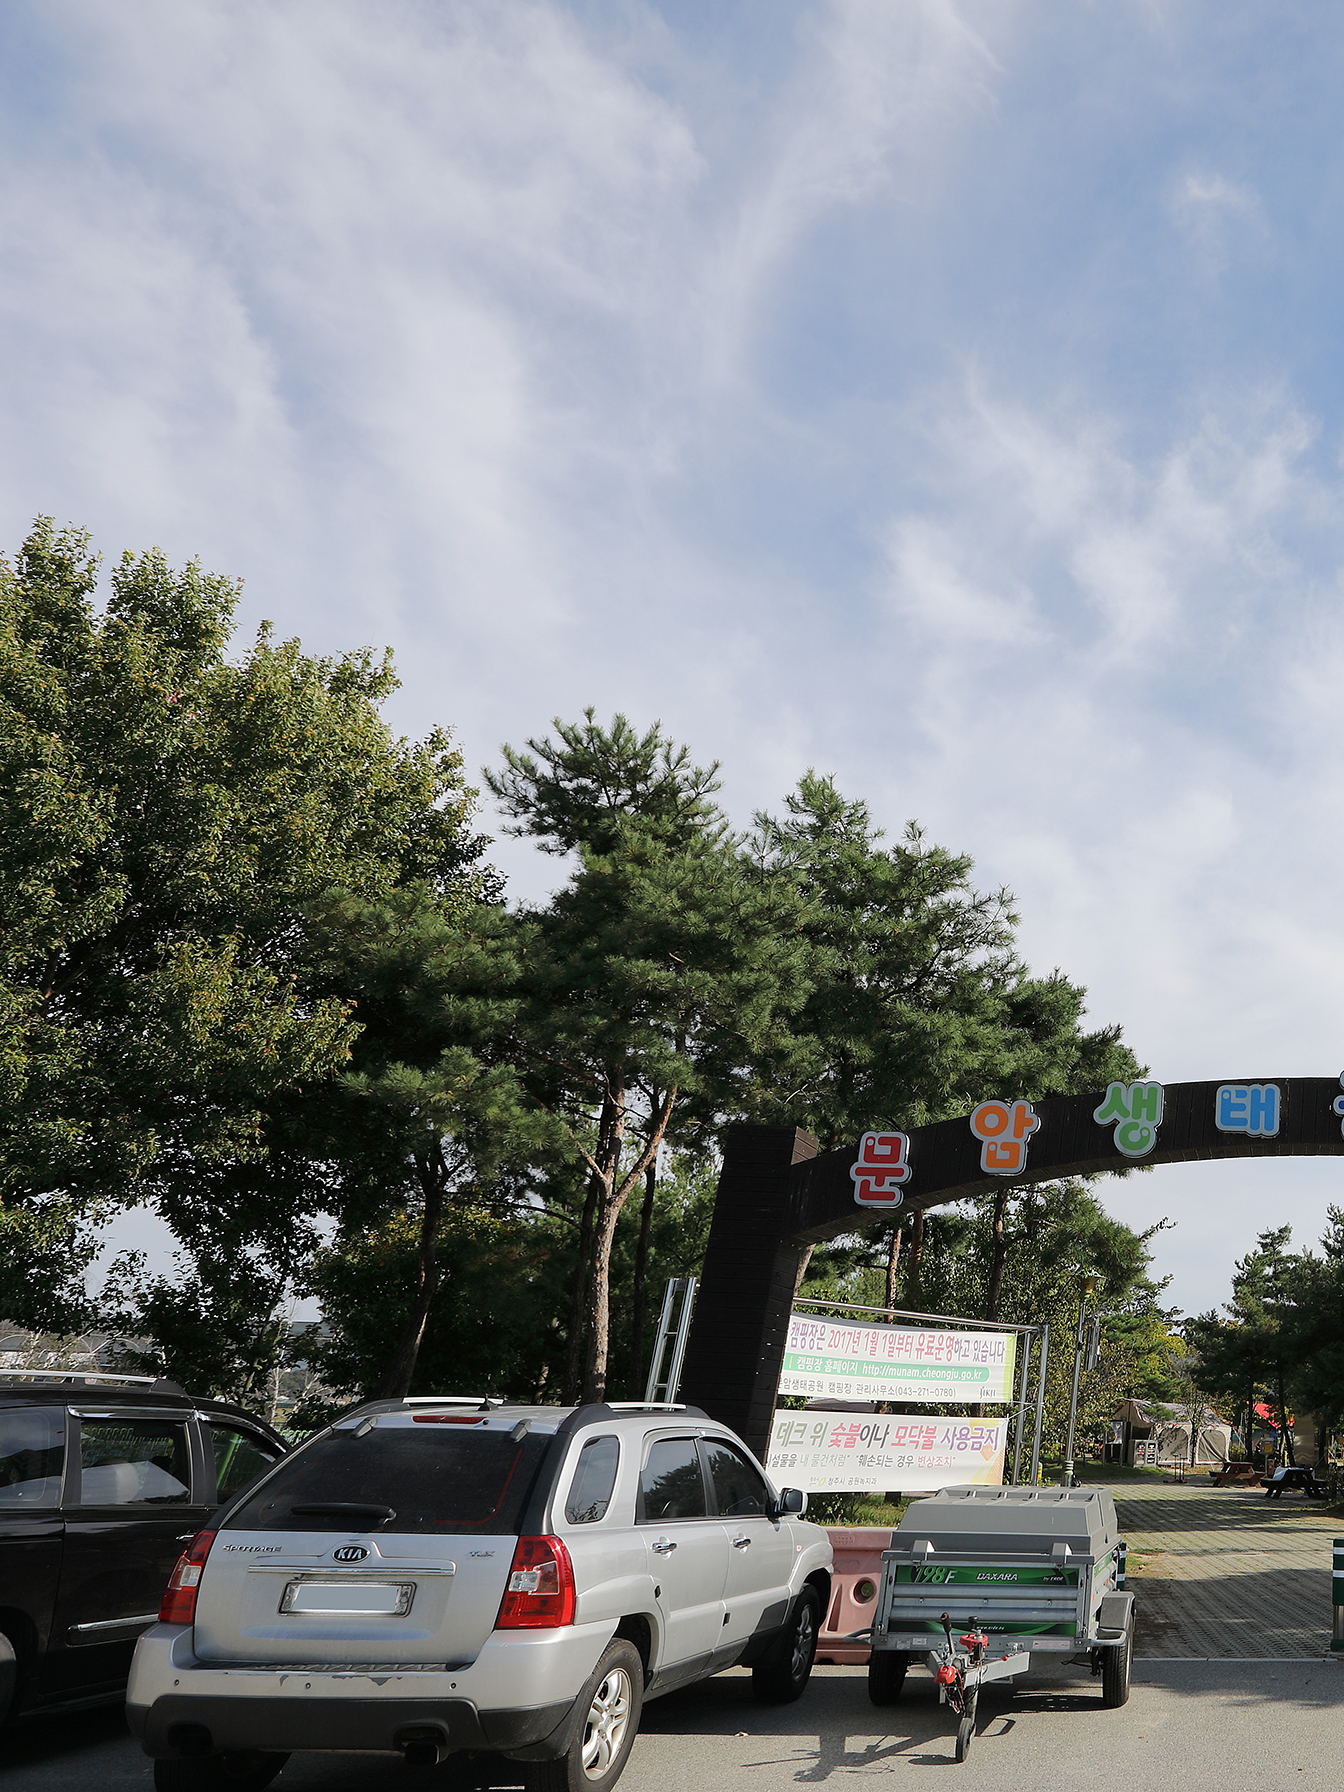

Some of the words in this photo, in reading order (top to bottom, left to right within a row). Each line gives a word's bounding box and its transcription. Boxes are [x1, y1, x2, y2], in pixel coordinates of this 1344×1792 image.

[790, 1321, 826, 1351] 캠핑장은
[828, 1329, 862, 1354] 2017년
[864, 1331, 880, 1356] 1월
[882, 1333, 914, 1358] 1일부터
[915, 1333, 970, 1362] 유료운영하고
[972, 1340, 1005, 1362] 있습니다
[797, 1356, 823, 1371] 캠핑장
[824, 1358, 859, 1374] 홈페이지
[862, 1363, 982, 1380] http://munam.cheongju.go.kr
[828, 1381, 852, 1394] 캠핑장
[776, 1420, 808, 1447] 데크
[809, 1421, 829, 1448] 위
[827, 1422, 890, 1449] 숯불이나
[891, 1425, 937, 1450] 모닥불
[940, 1426, 999, 1451] 사용금지
[897, 1455, 914, 1468] 경우
[976, 1572, 1018, 1581] DAXARA
